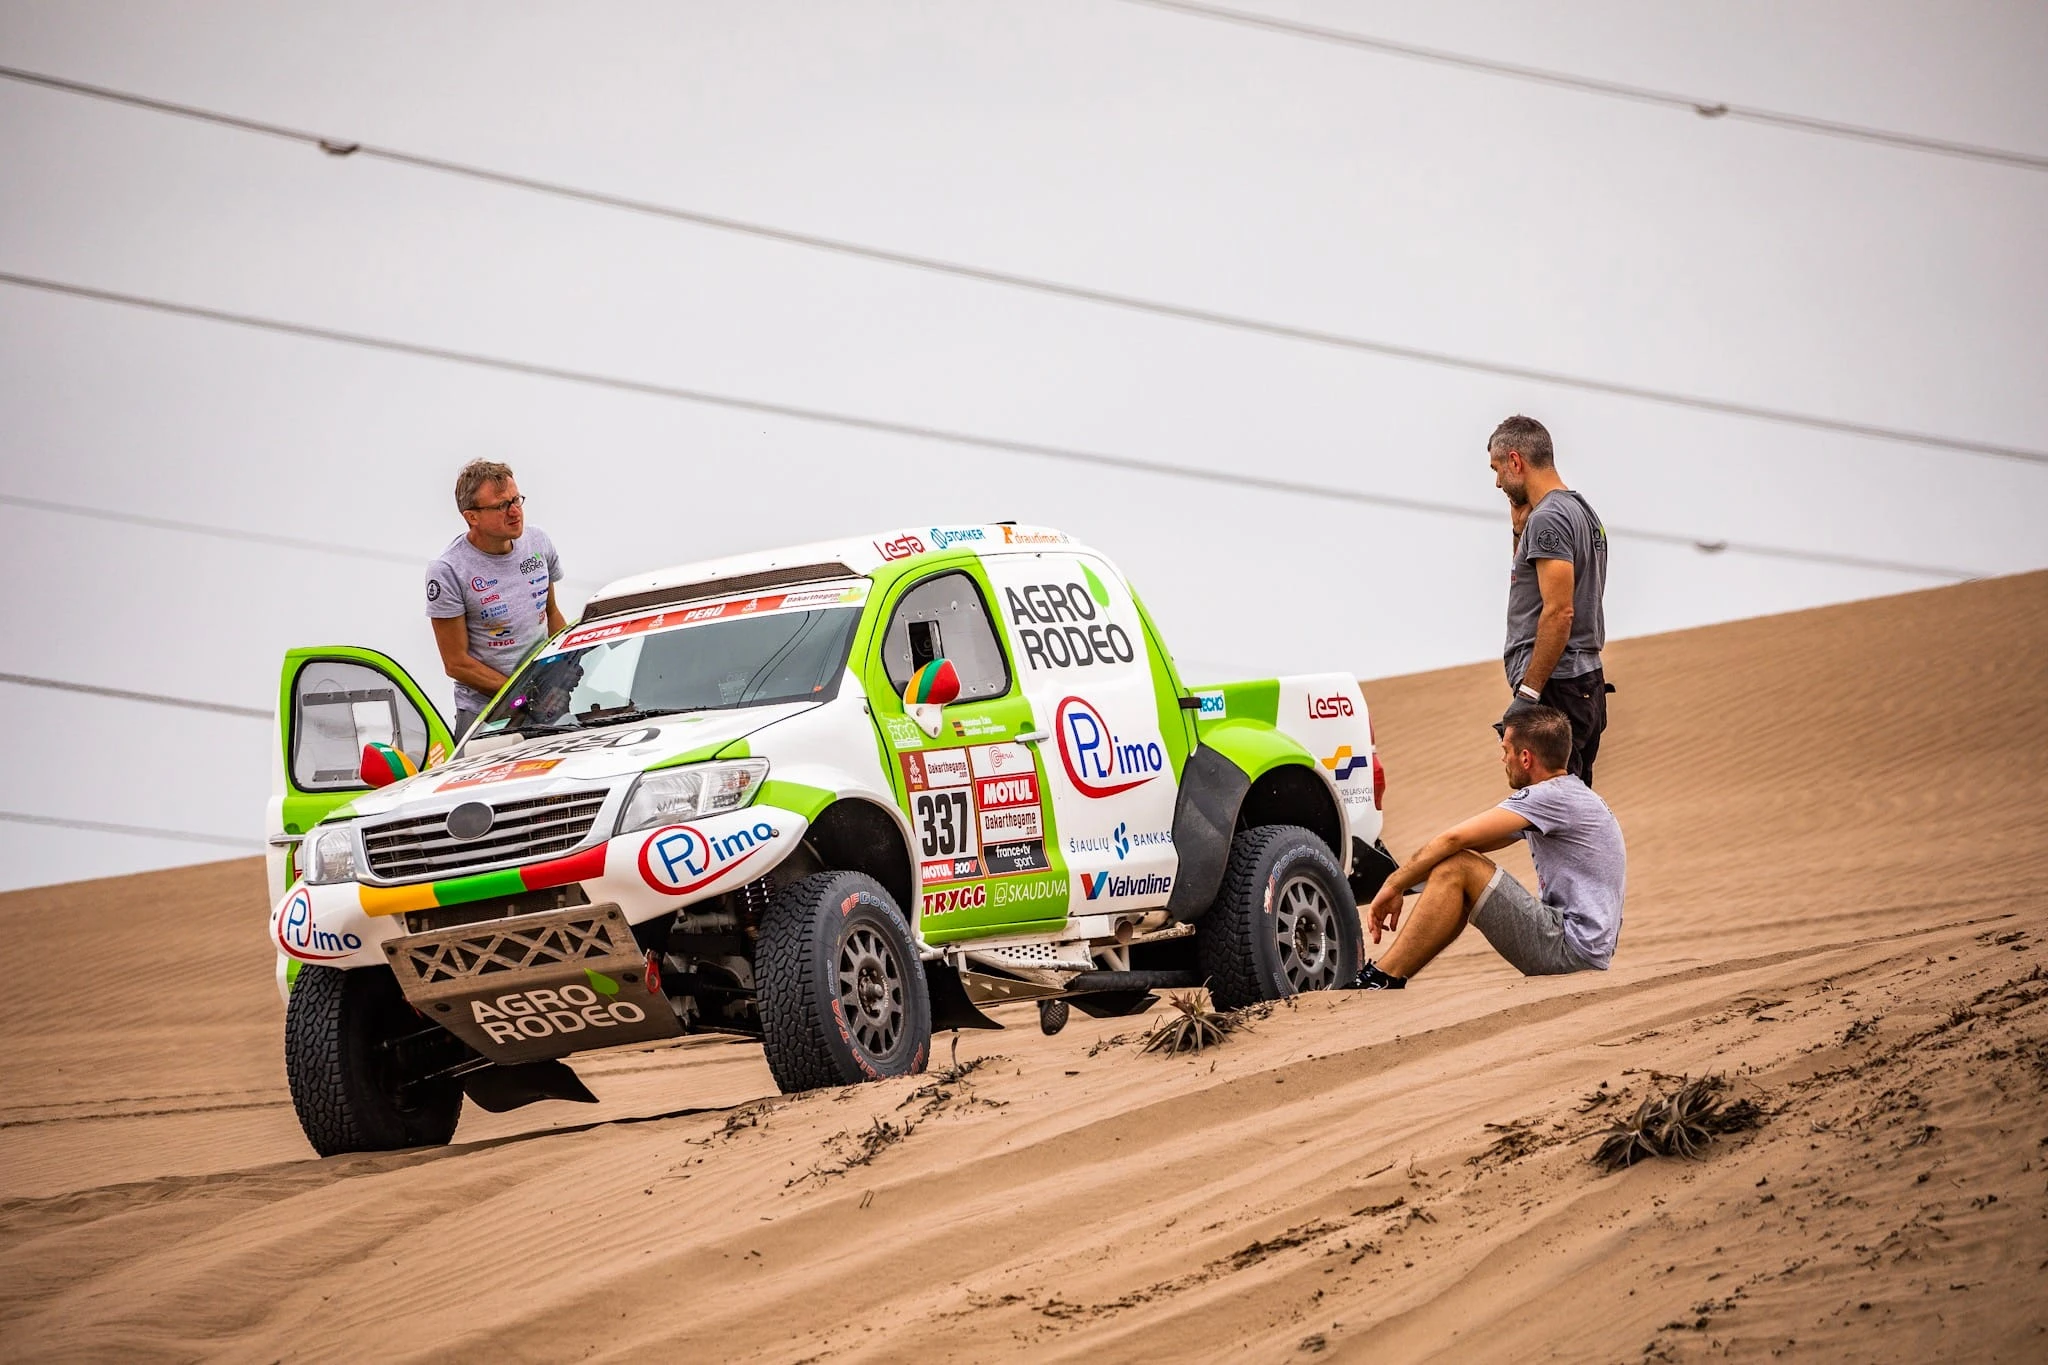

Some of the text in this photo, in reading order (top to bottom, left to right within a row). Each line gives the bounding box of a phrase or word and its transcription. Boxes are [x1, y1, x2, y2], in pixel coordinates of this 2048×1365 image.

[873, 532, 926, 562] Lesta
[945, 529, 986, 543] STOKKER
[520, 556, 537, 569] AGRO
[520, 560, 544, 576] RODEO
[1005, 582, 1097, 626] AGRO
[568, 625, 623, 645] MOTUL
[1019, 623, 1135, 671] RODEO
[1200, 695, 1224, 713] ECHO
[1307, 691, 1355, 720] Lesta
[983, 779, 1034, 805] MOTUL
[917, 791, 968, 857] 337
[985, 811, 1037, 830] Dakarthegame
[1070, 831, 1173, 853] ŠIAULIŲ BANKAS
[922, 859, 978, 880] MOTUL 300V
[1013, 856, 1036, 871] sport
[1008, 879, 1068, 902] SKAUDUVA
[1107, 873, 1171, 898] Valvoline
[921, 884, 986, 917] TRYGG
[470, 984, 599, 1024] AGRO
[481, 1001, 646, 1046] RODEO
